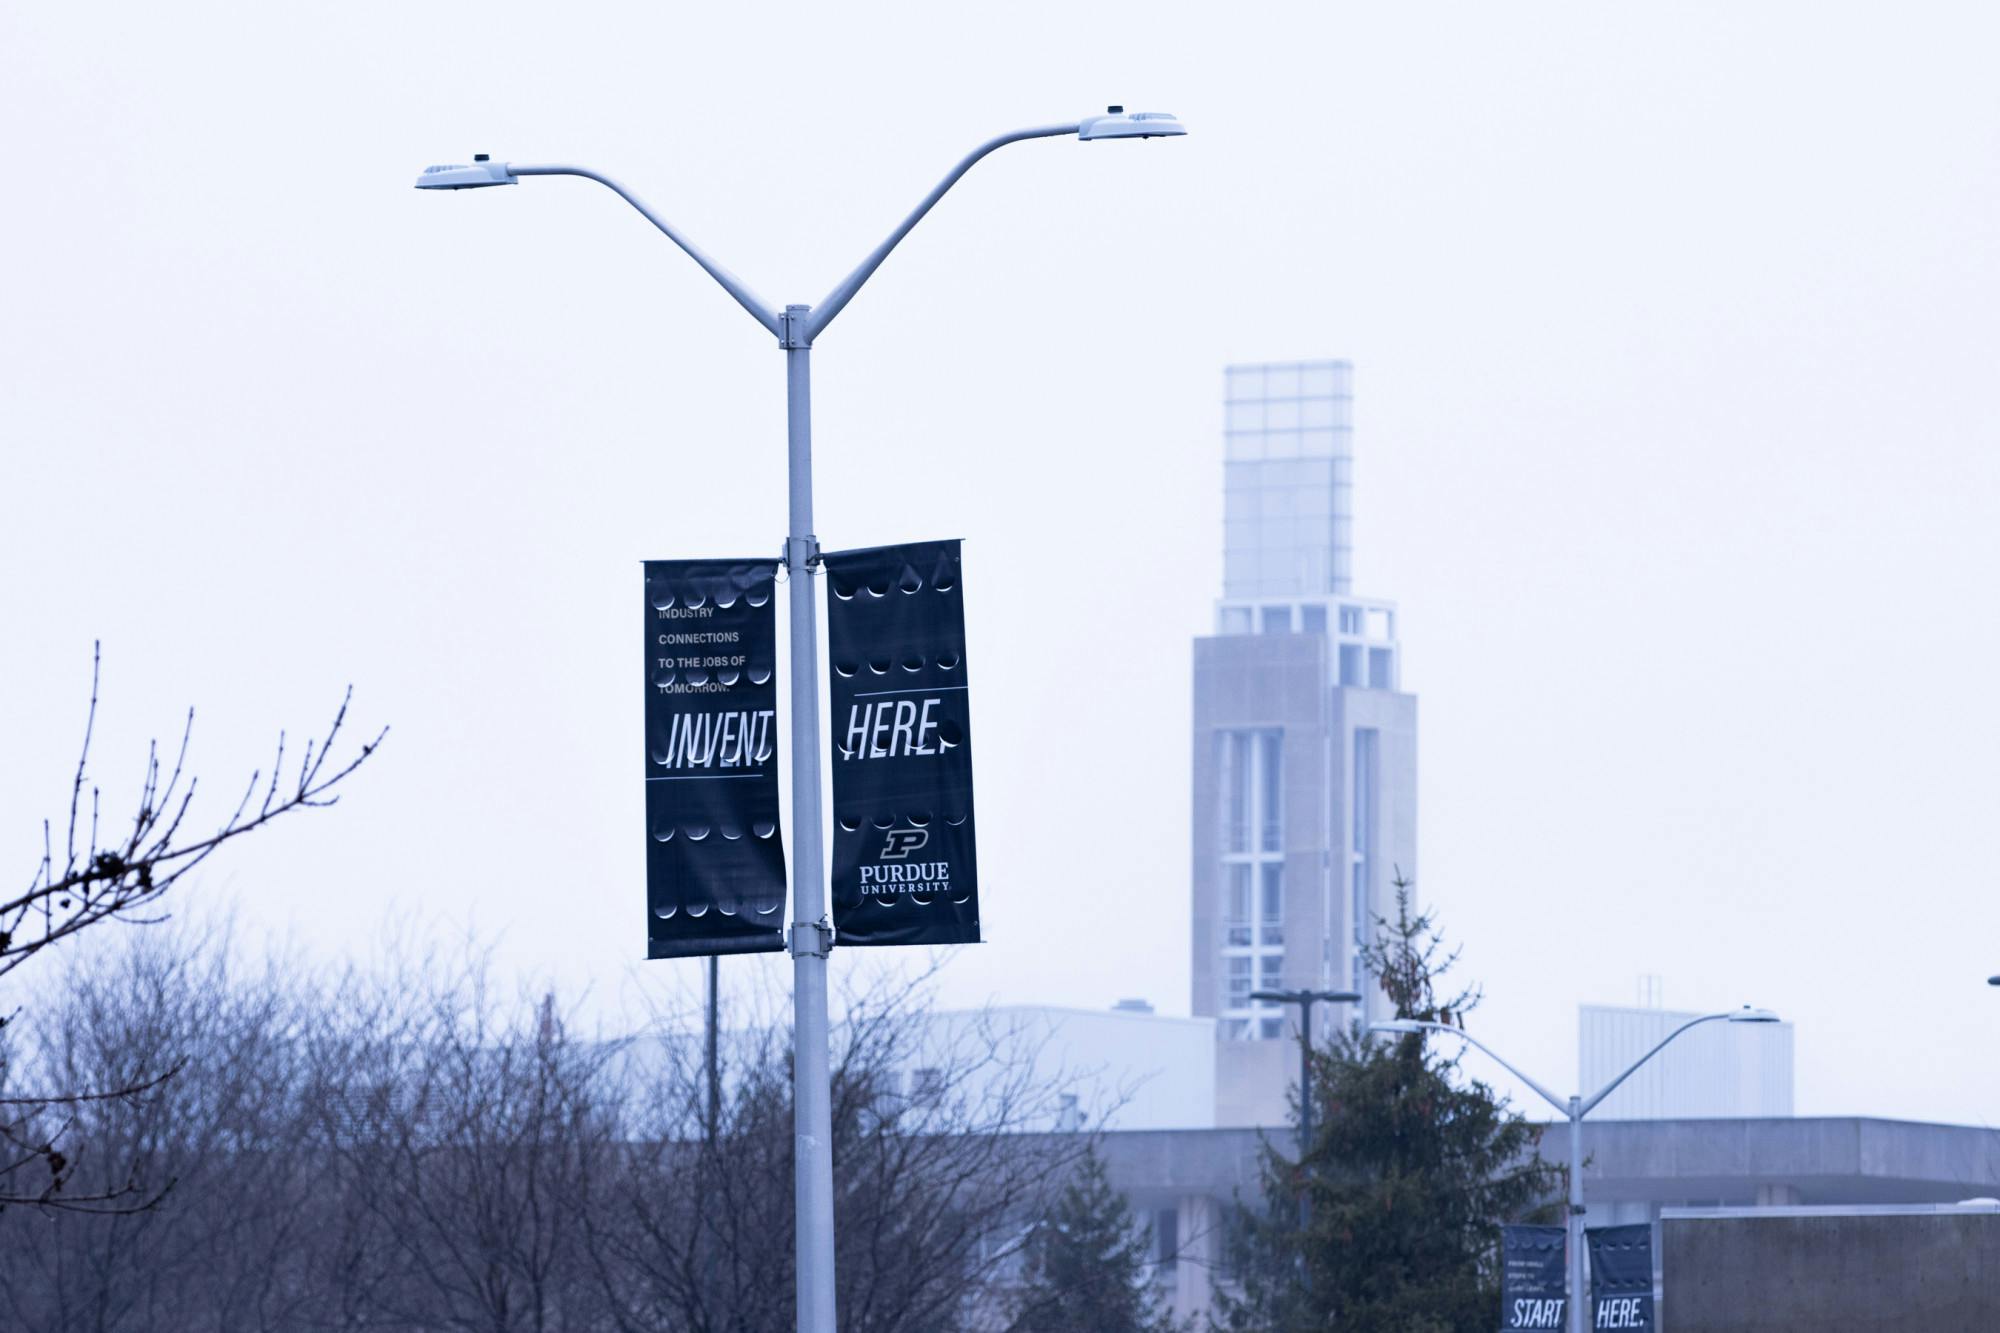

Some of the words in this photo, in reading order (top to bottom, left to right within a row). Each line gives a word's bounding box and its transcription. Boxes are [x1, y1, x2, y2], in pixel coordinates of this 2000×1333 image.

[658, 607, 714, 619] INDUSTRY
[658, 631, 740, 645] CONNECTIONS
[658, 658, 675, 669] TO
[677, 657, 701, 668] THE
[702, 656, 729, 668] JOBS
[730, 655, 746, 666] OF
[665, 710, 775, 769] INVENT
[880, 828, 929, 860] P
[859, 862, 949, 884] PURDUE
[861, 881, 950, 895] UNIVERSITY
[1510, 1298, 1565, 1328] START
[1596, 1297, 1644, 1329] HERE.
